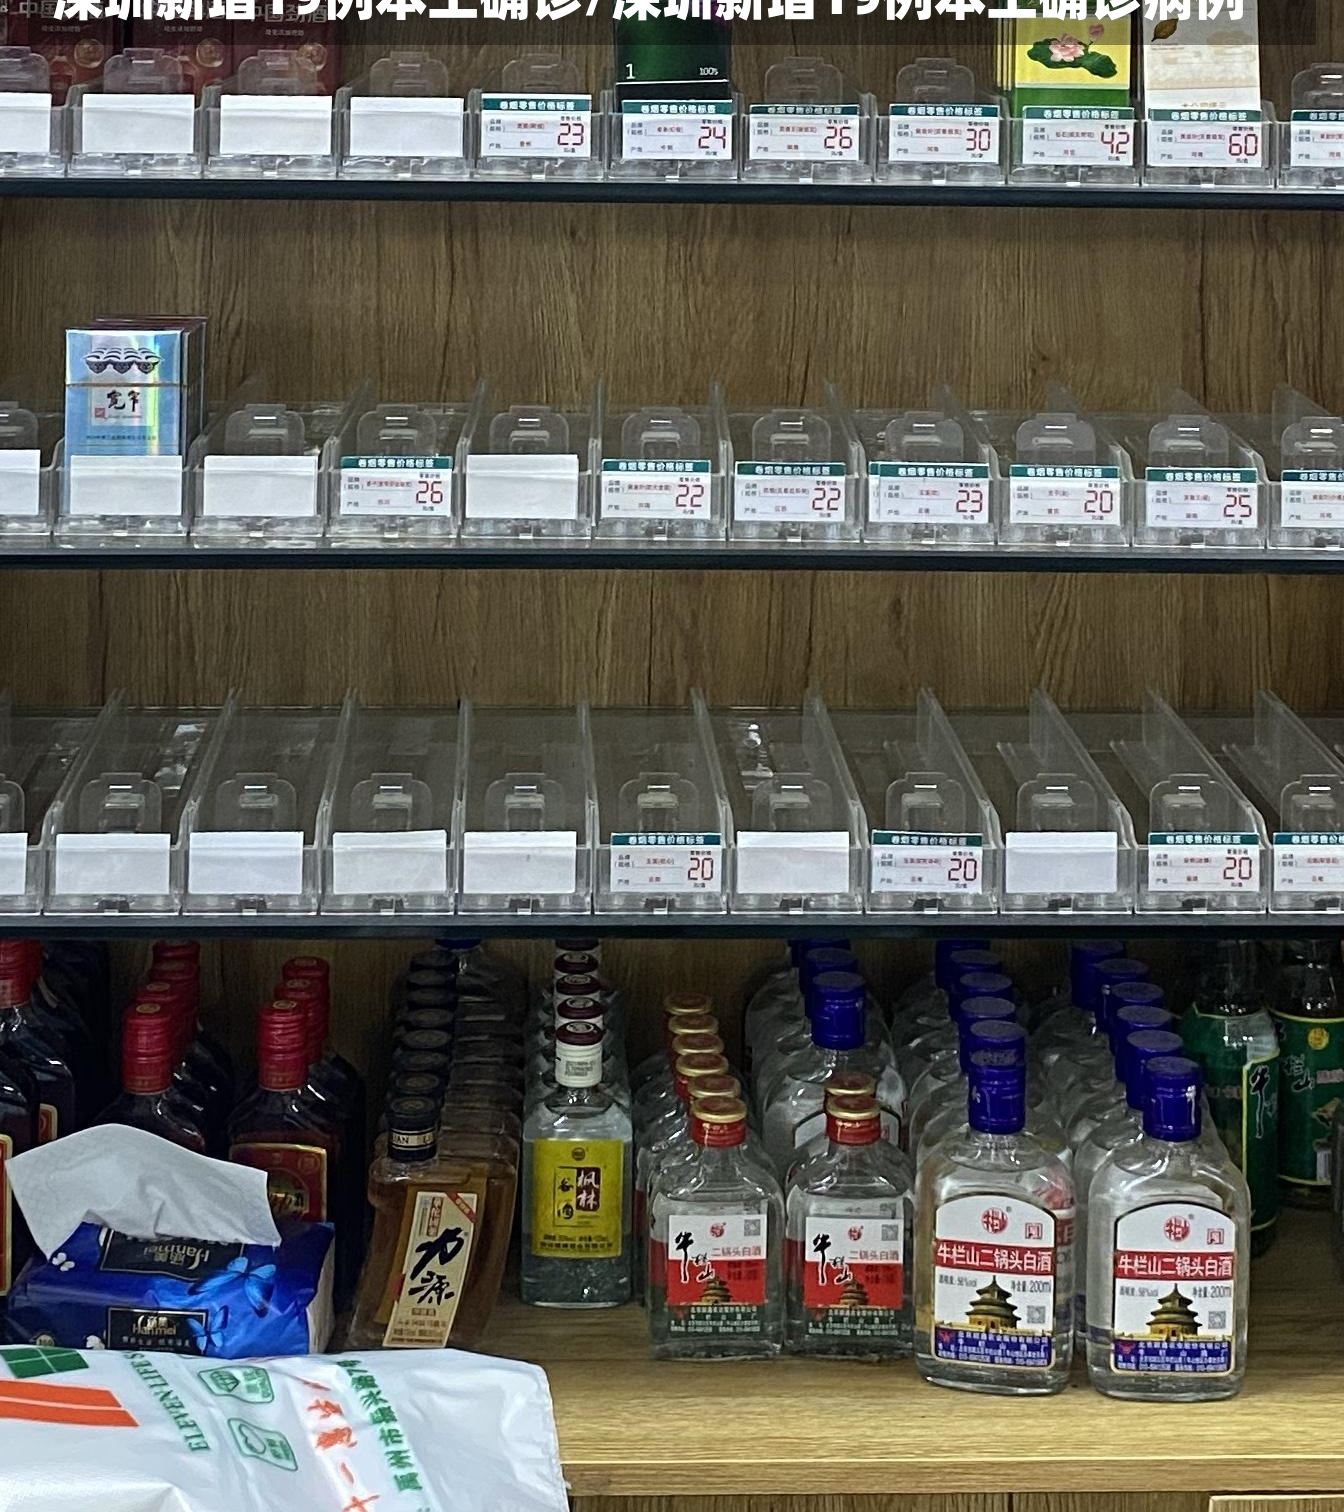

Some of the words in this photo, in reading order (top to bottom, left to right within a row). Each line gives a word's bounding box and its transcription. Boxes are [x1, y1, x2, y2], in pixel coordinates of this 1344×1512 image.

[625, 63, 636, 80] 1
[556, 123, 584, 147] 23
[698, 125, 727, 150] 24
[824, 125, 853, 150] 26
[674, 484, 705, 509] 22
[956, 490, 984, 513] 23
[1083, 490, 1113, 513] 20
[1222, 493, 1252, 517] 25
[575, 1169, 600, 1210] 枫林
[937, 1242, 1052, 1273] 牛栏山二锅头白酒
[1117, 1254, 1233, 1277] 牛栏山二锅头白酒
